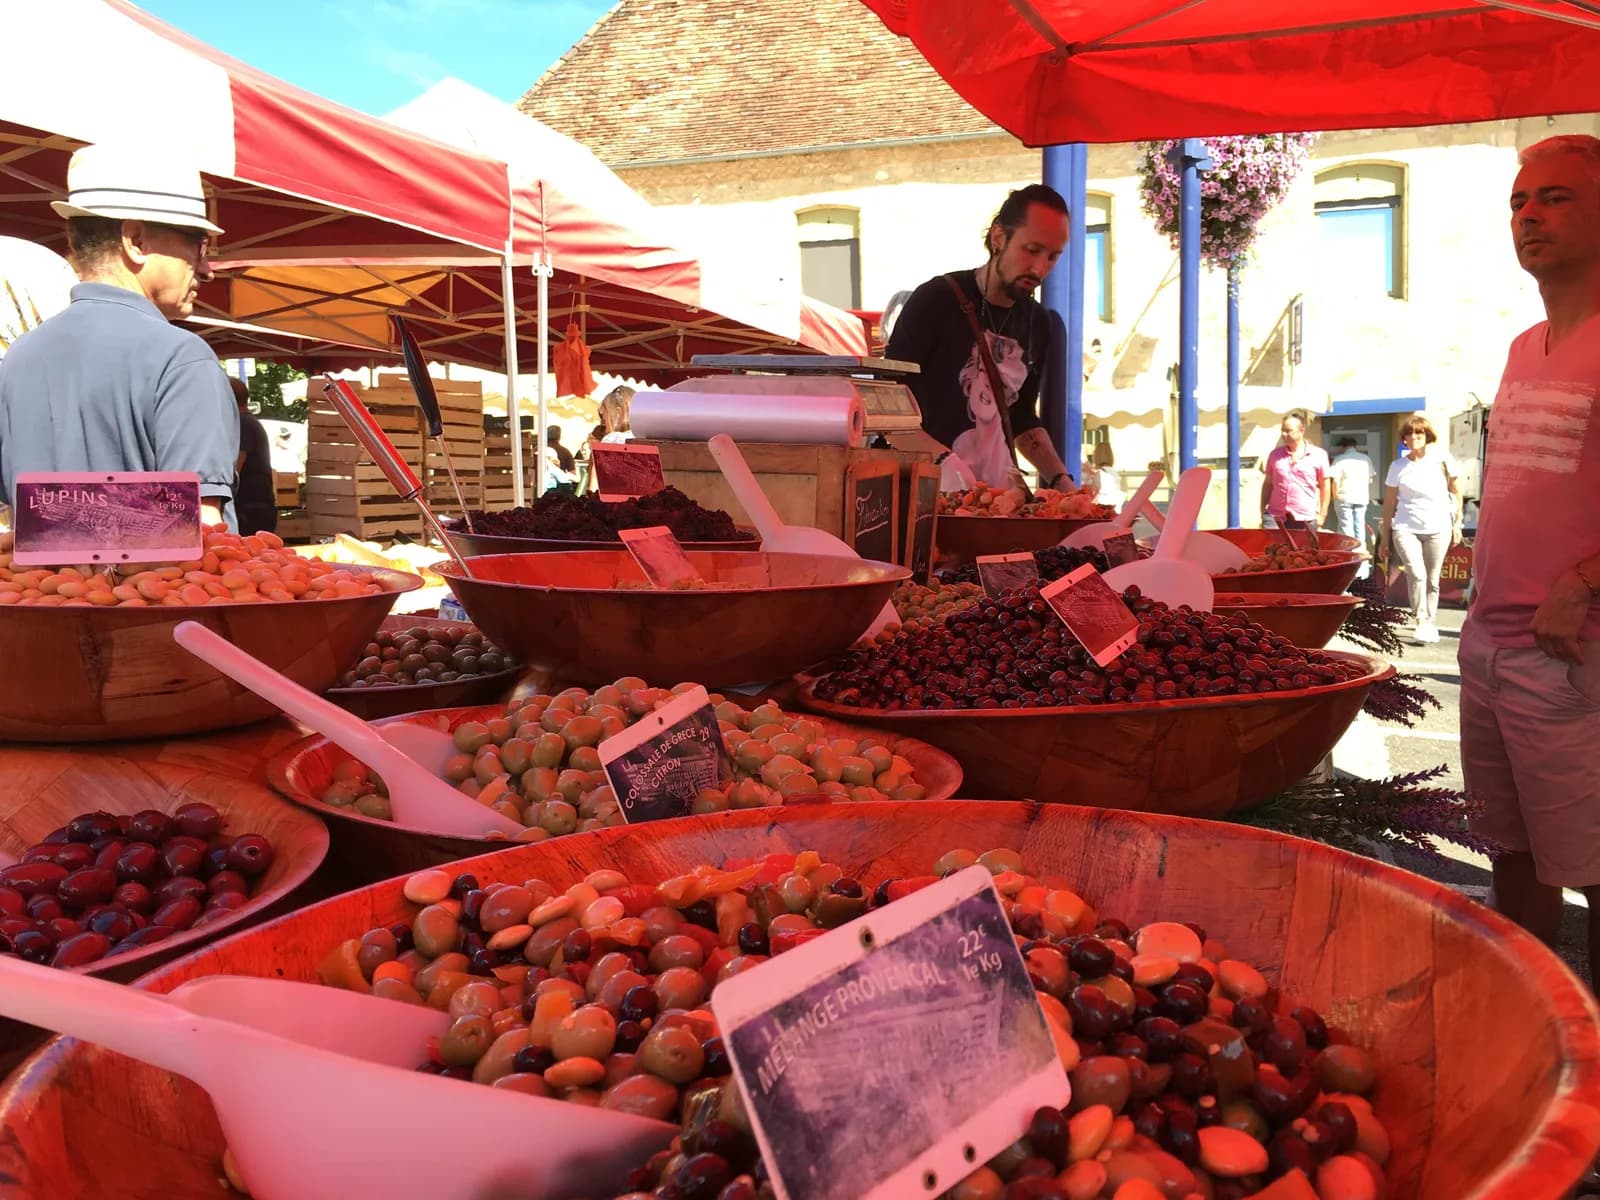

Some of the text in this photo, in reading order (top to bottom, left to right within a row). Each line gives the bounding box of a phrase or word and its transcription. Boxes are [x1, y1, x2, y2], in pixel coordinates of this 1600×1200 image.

[29, 489, 108, 510] LUPINS
[625, 727, 696, 809] COLOSSALE DE GRECE
[651, 757, 681, 788] CITRON
[962, 951, 1002, 982] le Kg
[757, 995, 841, 1096] MELANGE
